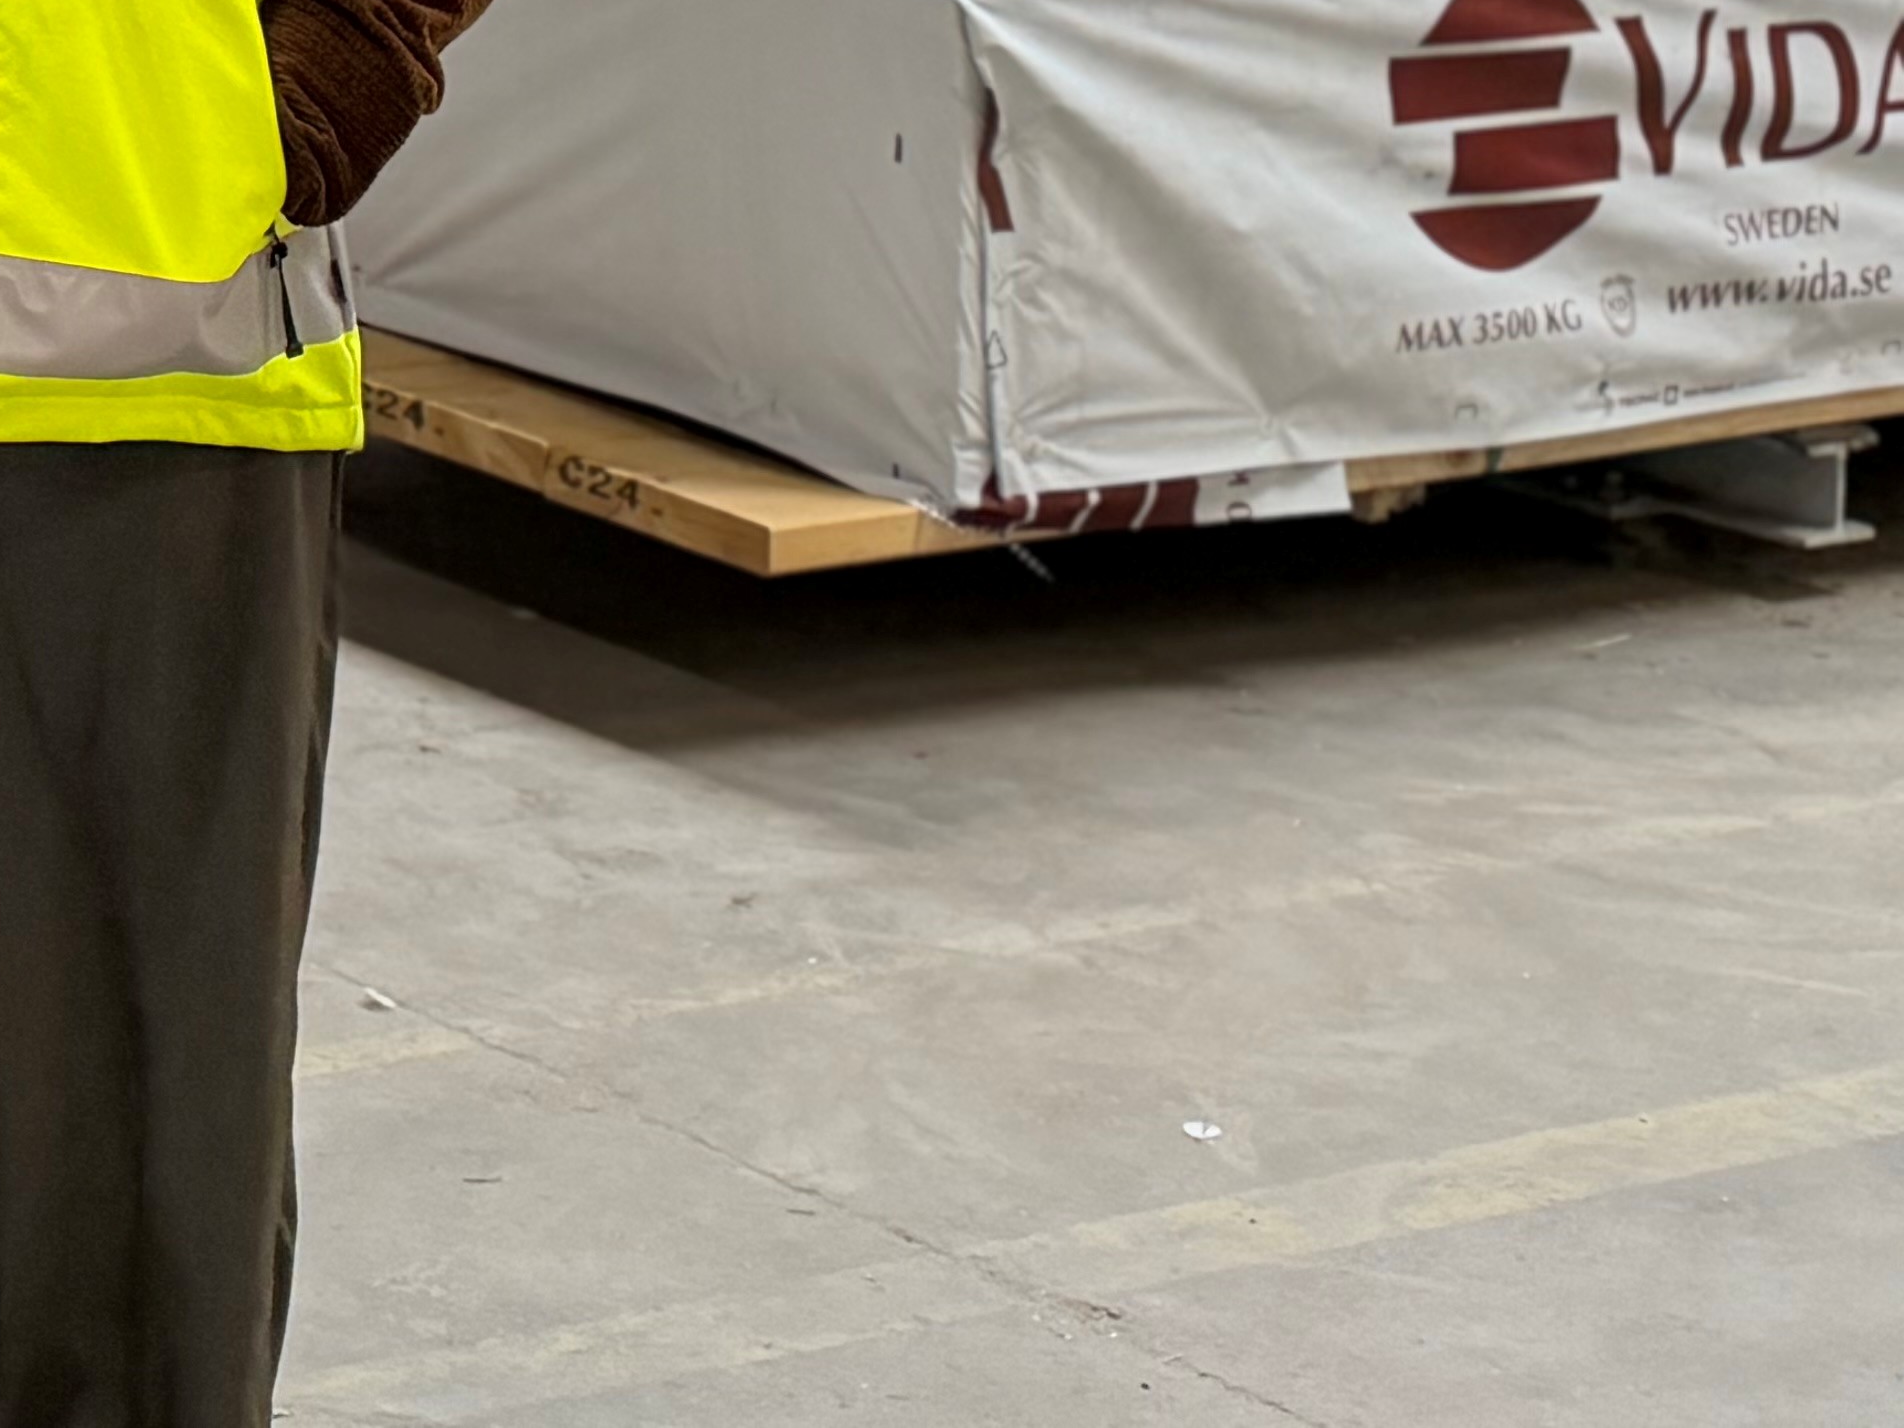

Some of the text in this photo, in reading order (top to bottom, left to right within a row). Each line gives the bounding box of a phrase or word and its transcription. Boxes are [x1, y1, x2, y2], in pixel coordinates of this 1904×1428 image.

[1723, 202, 1841, 246] SWEDEN
[1667, 257, 1893, 315] www.vida.se
[1395, 298, 1583, 352] MAX 3500 KG
[557, 454, 640, 512] C24
